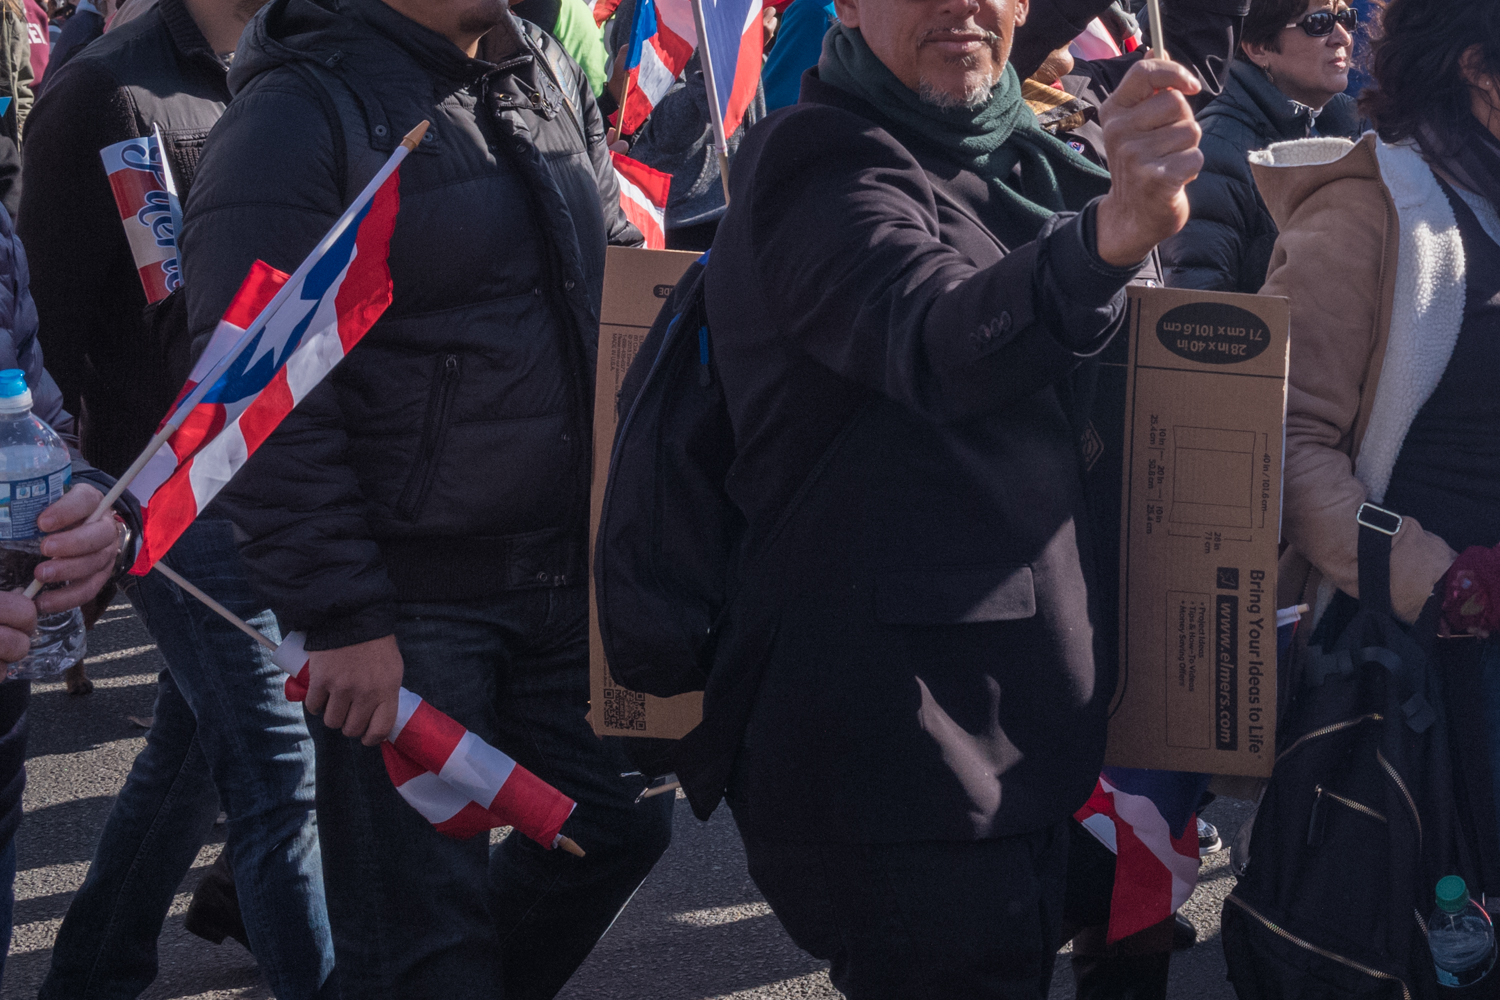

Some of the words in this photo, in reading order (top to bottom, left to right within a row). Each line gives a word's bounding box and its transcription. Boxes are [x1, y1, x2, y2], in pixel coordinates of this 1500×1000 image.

[1162, 322, 1181, 331] cm
[1183, 323, 1213, 336] 101.6
[1217, 326, 1224, 334] x
[1226, 327, 1245, 336] cm
[1249, 328, 1262, 340] 71
[1176, 339, 1188, 350] in
[1190, 340, 1206, 352] 40
[1207, 341, 1215, 349] x
[1217, 342, 1229, 353] in
[1230, 343, 1246, 355] 28
[1149, 432, 1155, 444] cm
[1263, 452, 1270, 463] 40
[1146, 477, 1153, 489] cm
[1261, 479, 1269, 498] 101.6
[1261, 499, 1267, 511] cm
[1145, 522, 1152, 534] cm
[1204, 541, 1210, 554] cm
[1246, 569, 1264, 613] Bring
[1177, 605, 1186, 633] Money
[1188, 606, 1196, 622] Tips
[1197, 606, 1205, 635] Project
[1248, 617, 1264, 656] Your
[1176, 633, 1185, 661] Saving
[1187, 631, 1196, 664] How-To
[1177, 662, 1185, 686] Offers
[1214, 602, 1236, 742] www.elmers.com
[1247, 660, 1263, 703] Ideas
[1248, 707, 1262, 721] to
[1248, 725, 1263, 753] Life
